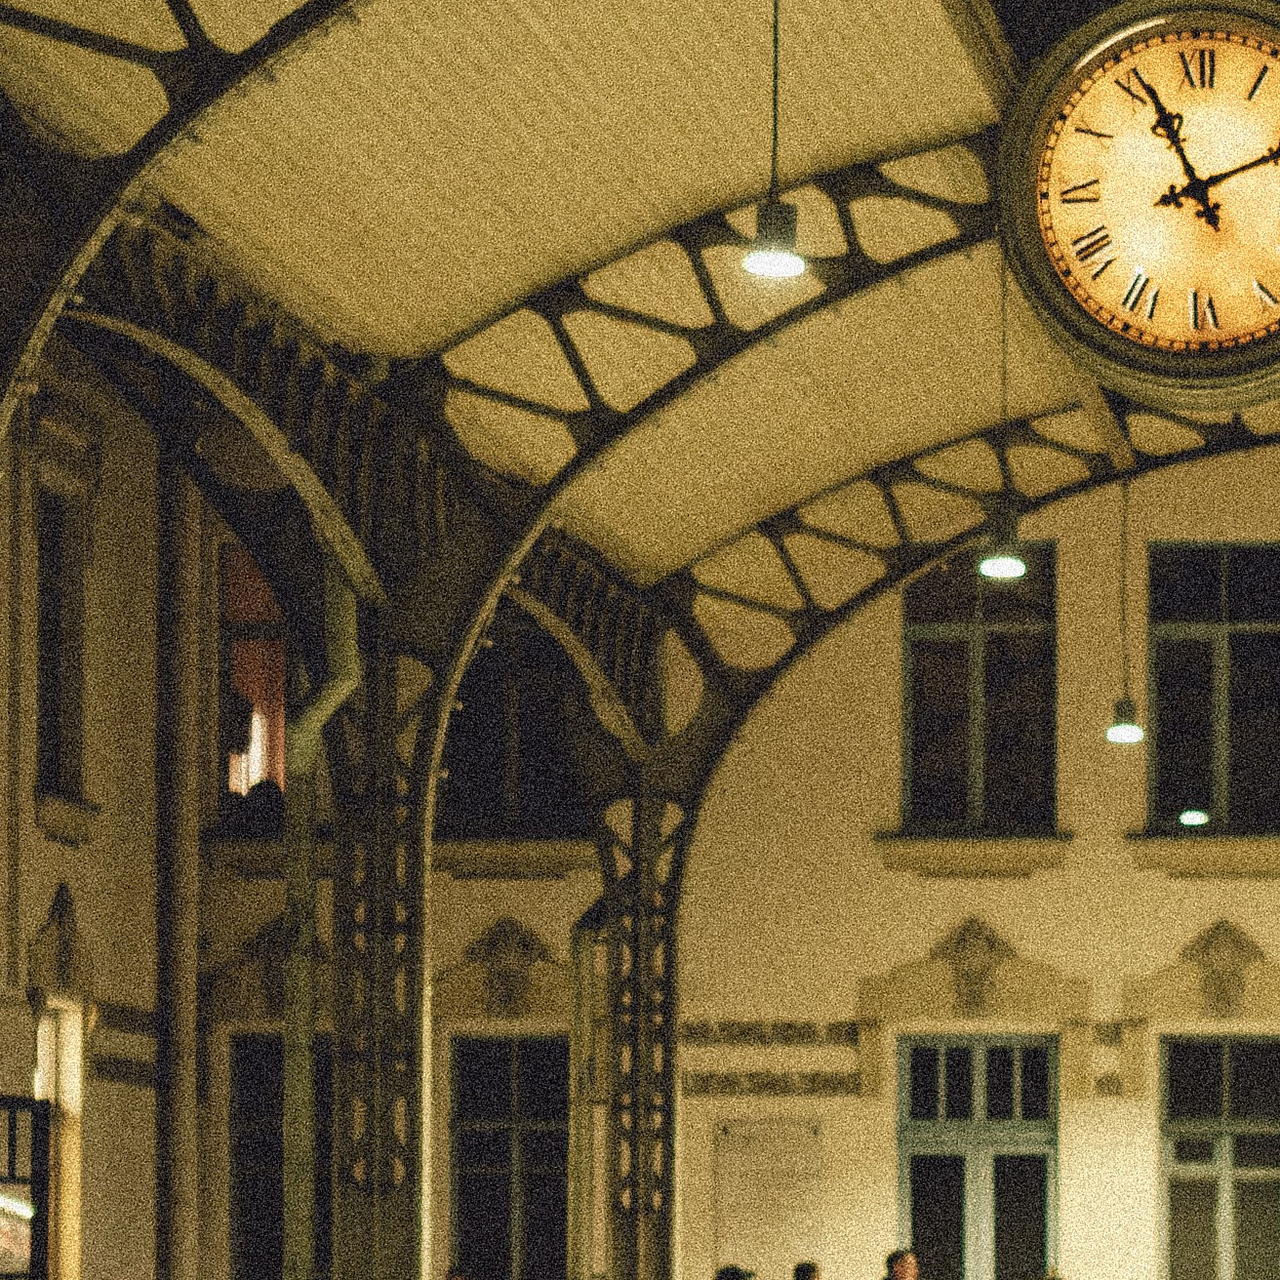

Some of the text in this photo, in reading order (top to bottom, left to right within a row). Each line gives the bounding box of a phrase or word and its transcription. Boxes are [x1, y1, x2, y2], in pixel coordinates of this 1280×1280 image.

[1177, 49, 1216, 91] XII
[1247, 63, 1270, 101] I
[1070, 224, 1117, 282] VIII
[1121, 272, 1160, 320] VII
[1192, 289, 1220, 331] VI
